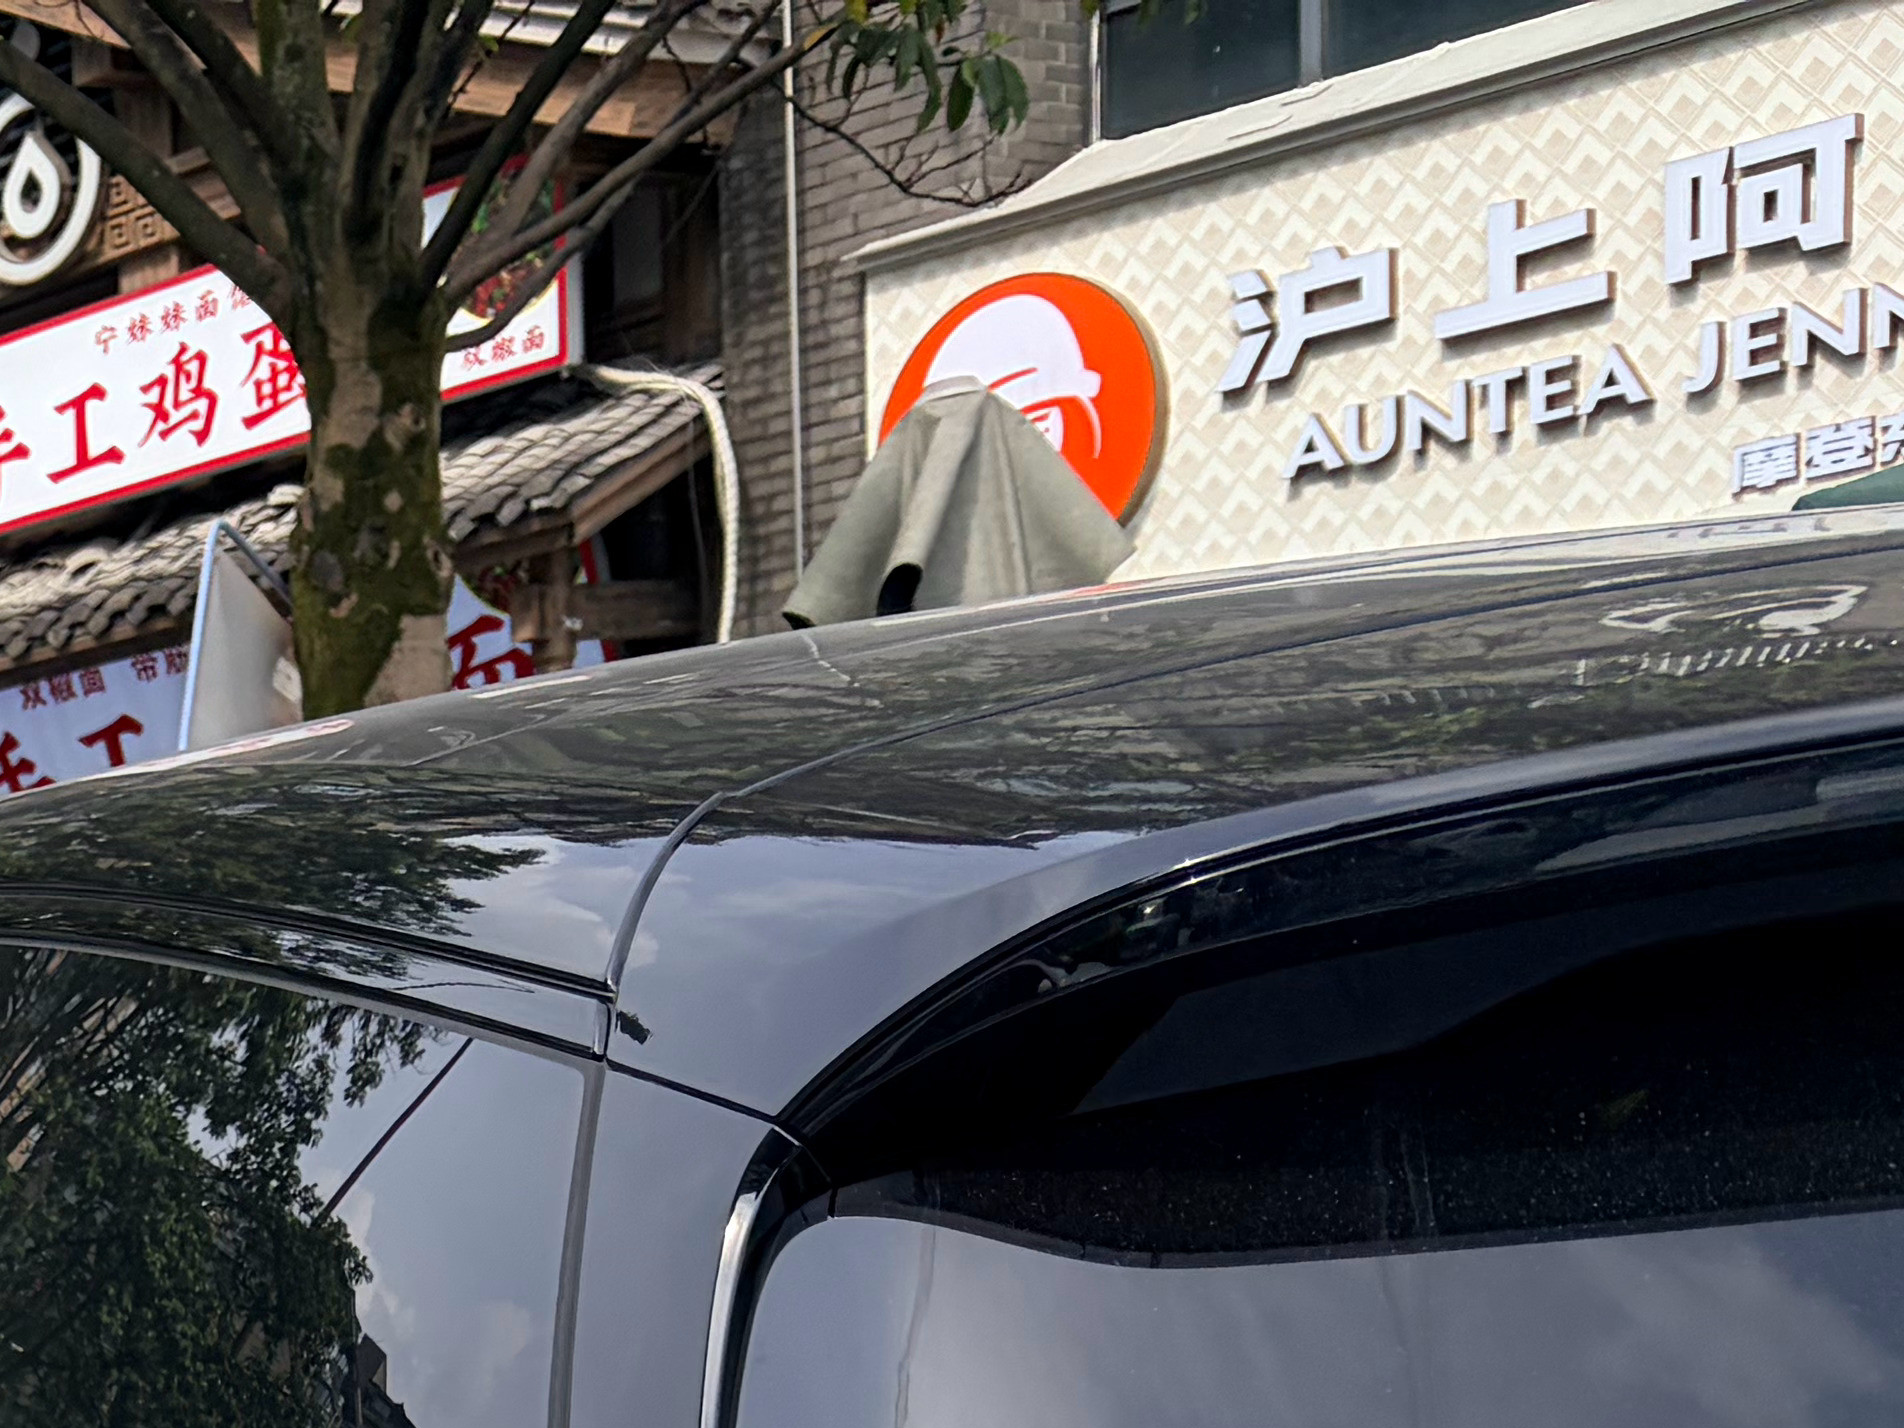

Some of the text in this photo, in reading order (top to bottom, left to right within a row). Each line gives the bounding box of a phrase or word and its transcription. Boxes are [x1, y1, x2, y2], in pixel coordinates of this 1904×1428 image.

[1217, 113, 1864, 394] 沪上阿
[1282, 342, 1656, 480] AUNTEA
